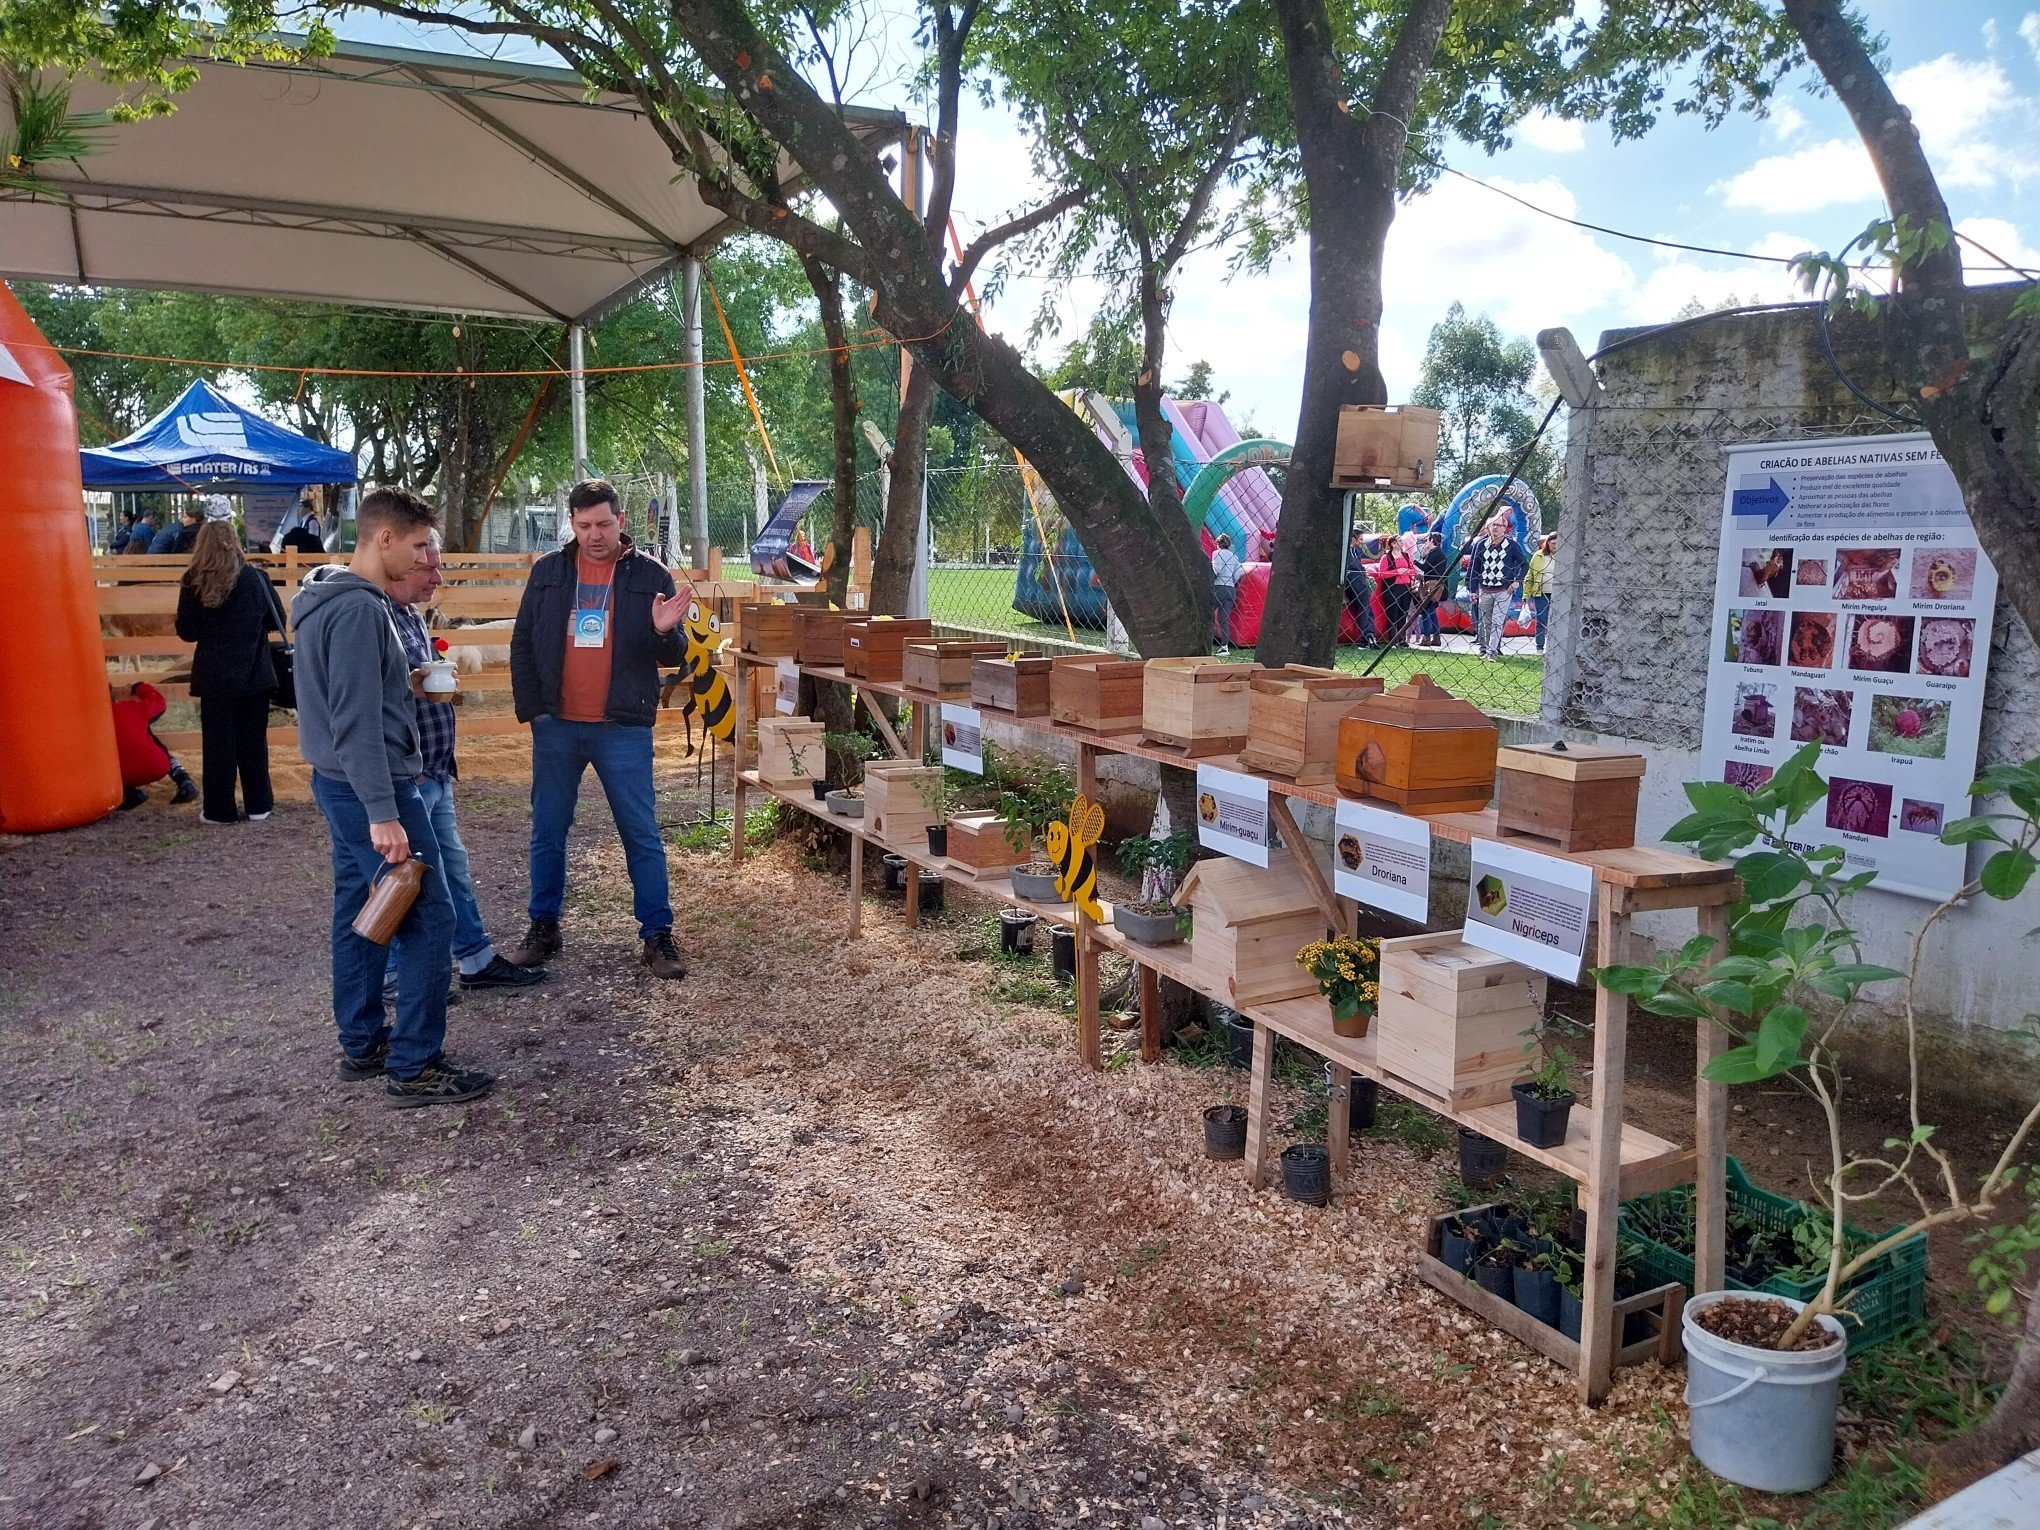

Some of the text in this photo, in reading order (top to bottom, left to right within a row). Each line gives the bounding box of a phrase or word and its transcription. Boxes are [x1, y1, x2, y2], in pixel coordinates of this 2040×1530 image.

[1801, 458, 1812, 467] DE
[1815, 455, 1857, 467] ABELHAS
[1860, 452, 1903, 464] NATIVAS
[1905, 451, 1927, 461] SEM
[1872, 481, 1900, 489] qualidade
[1740, 494, 1779, 506] Objetivos
[1769, 533, 1810, 542] Identificação
[1812, 533, 1824, 541] das
[1826, 533, 1859, 542] espécies
[1873, 532, 1903, 541] abelhas
[1905, 532, 1914, 540] de
[1917, 532, 1945, 542] região:
[1791, 670, 1826, 679] Mandaguari
[1853, 675, 1894, 685] Mirim Guaçu
[1733, 744, 1752, 752] Abelha
[1824, 748, 1839, 756] chão
[1891, 756, 1913, 765] Irapuá
[1219, 820, 1259, 841] Mirim-guaçu
[1842, 832, 1869, 843] Manduri
[1371, 865, 1407, 886] Droriana
[1511, 918, 1560, 946] Nigriceps
